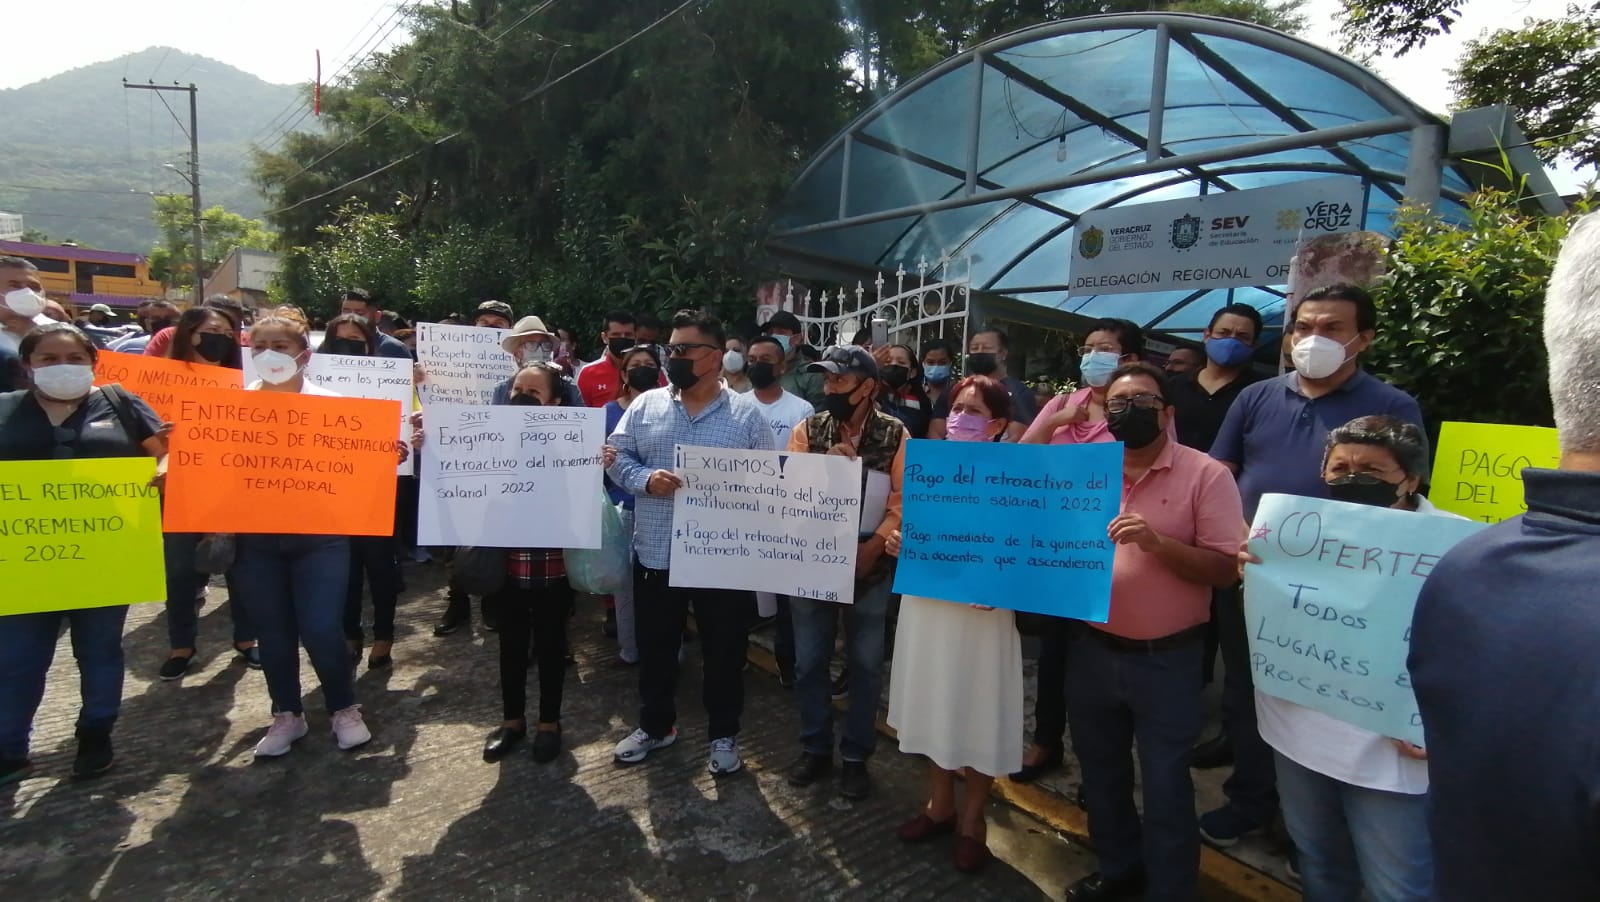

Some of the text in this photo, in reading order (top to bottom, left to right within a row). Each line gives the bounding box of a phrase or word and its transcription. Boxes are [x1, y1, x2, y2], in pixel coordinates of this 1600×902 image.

[1306, 201, 1352, 217] VERA
[1110, 224, 1152, 235] VERACRUZ
[1211, 216, 1250, 230] SEV
[1304, 215, 1351, 231] CRUZ
[1108, 241, 1154, 252] DEL ESTADO
[1109, 233, 1148, 243] GOBIERNO
[1077, 270, 1160, 288] DELEGACIÓN
[1172, 267, 1252, 281] REGIONAL
[431, 345, 471, 361] Respeto
[96, 363, 129, 382] AGO
[424, 360, 447, 369] para
[316, 374, 333, 385] que
[357, 372, 372, 384] los
[181, 401, 278, 423] ENTREGA
[288, 409, 311, 426] DE
[323, 413, 362, 431] LAS
[459, 411, 491, 422] SNTE
[572, 412, 588, 420] 32
[288, 432, 305, 447] DE
[439, 427, 584, 450] Exigimos pago del
[178, 450, 354, 475] DE CONTRATACIÓN
[440, 455, 603, 471] retroactivo del incremento
[1460, 449, 1532, 480] PAGO
[244, 478, 337, 495] TEMPORAL
[904, 464, 1108, 490] Pago del retroactivo del
[0, 482, 160, 501] EL RETROACTIVO
[501, 481, 535, 495] 2022
[685, 473, 720, 498] Pago
[794, 487, 812, 503] del
[1456, 481, 1498, 504] DEL
[686, 496, 848, 522] institucional a familiares
[907, 493, 1102, 512] incremento salarial 2022
[0, 515, 124, 536] NCREMENTO
[686, 519, 836, 551] Pago del retroactivo del
[904, 522, 1107, 554] Pago inmediato de la quincena
[24, 544, 86, 562] 2022
[685, 541, 750, 556] incremento
[812, 554, 849, 565] 2022
[903, 549, 1105, 571] 15 a docentes que ascendieron
[1288, 583, 1369, 630] TODOS
[1257, 616, 1370, 677] LUGARES
[1252, 653, 1385, 712] PROCESOS
